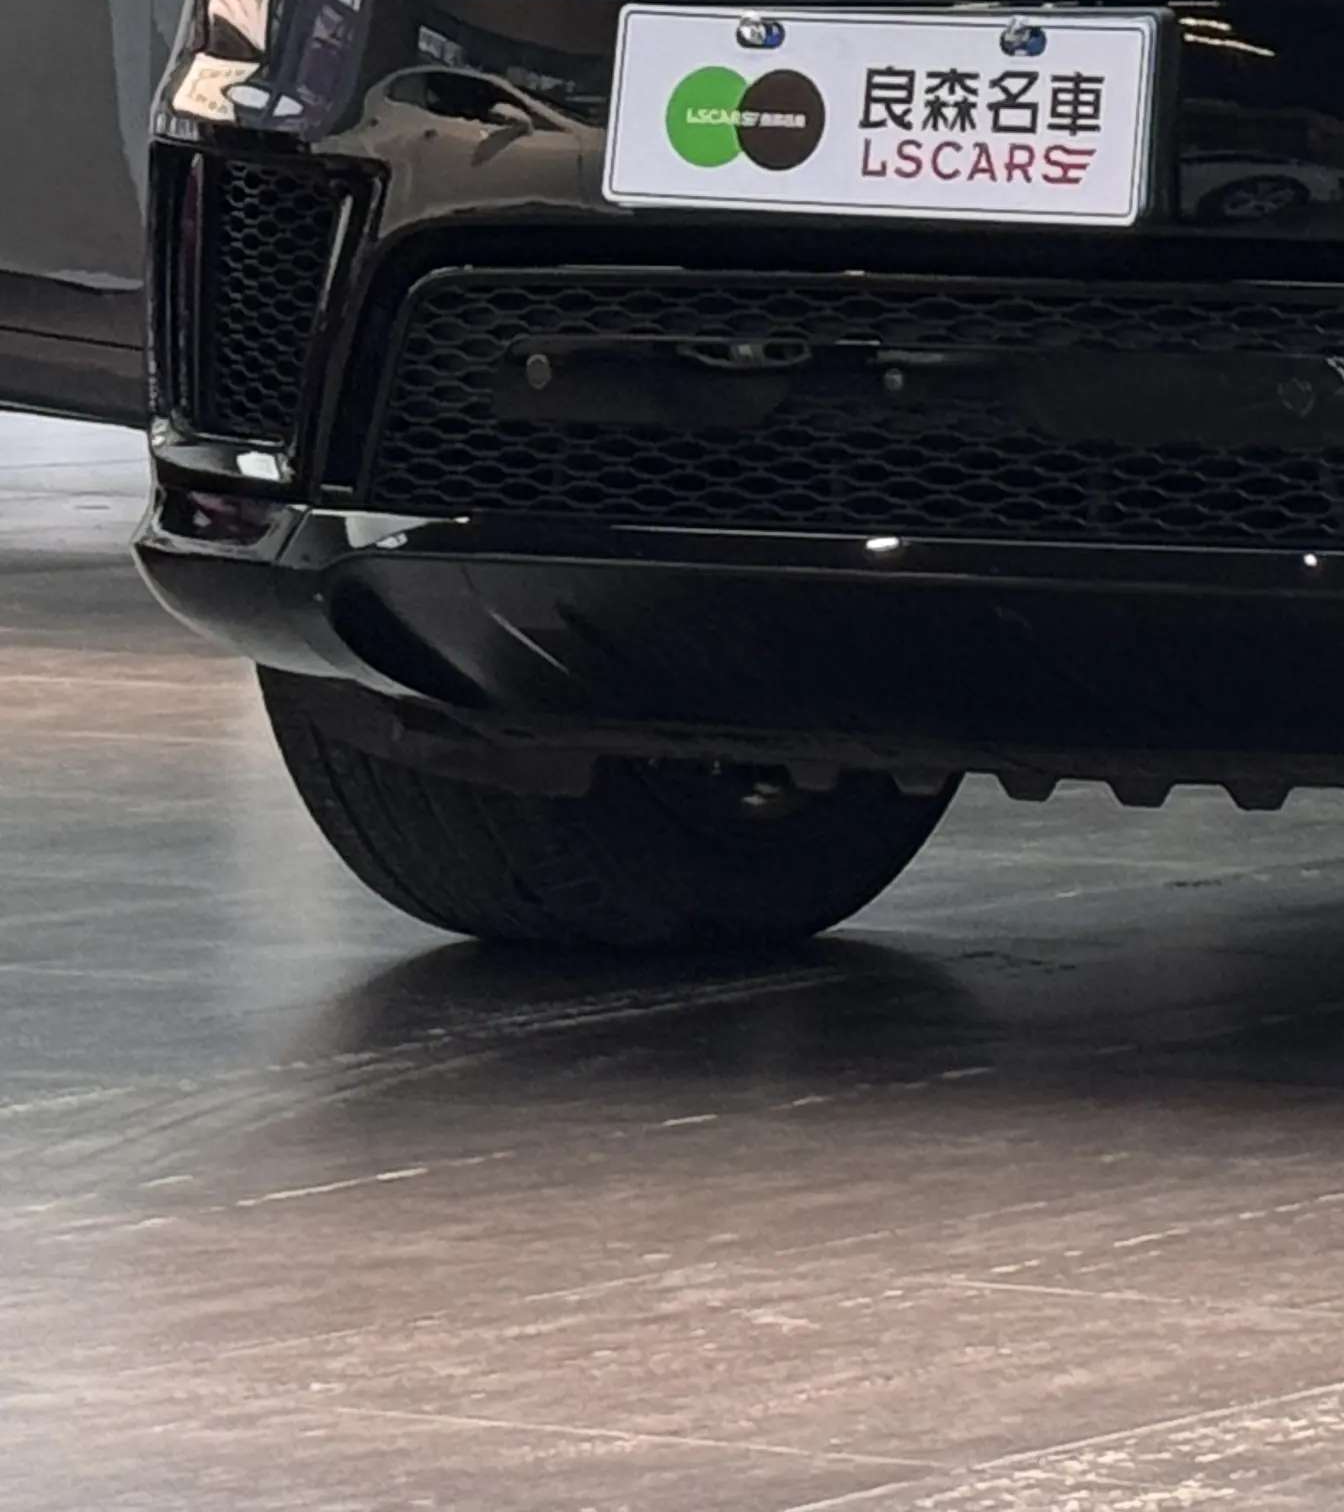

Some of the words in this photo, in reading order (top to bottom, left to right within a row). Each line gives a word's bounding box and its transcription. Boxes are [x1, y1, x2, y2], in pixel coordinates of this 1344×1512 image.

[858, 65, 1105, 136] 良森名車
[861, 138, 1097, 185] LSCARS
